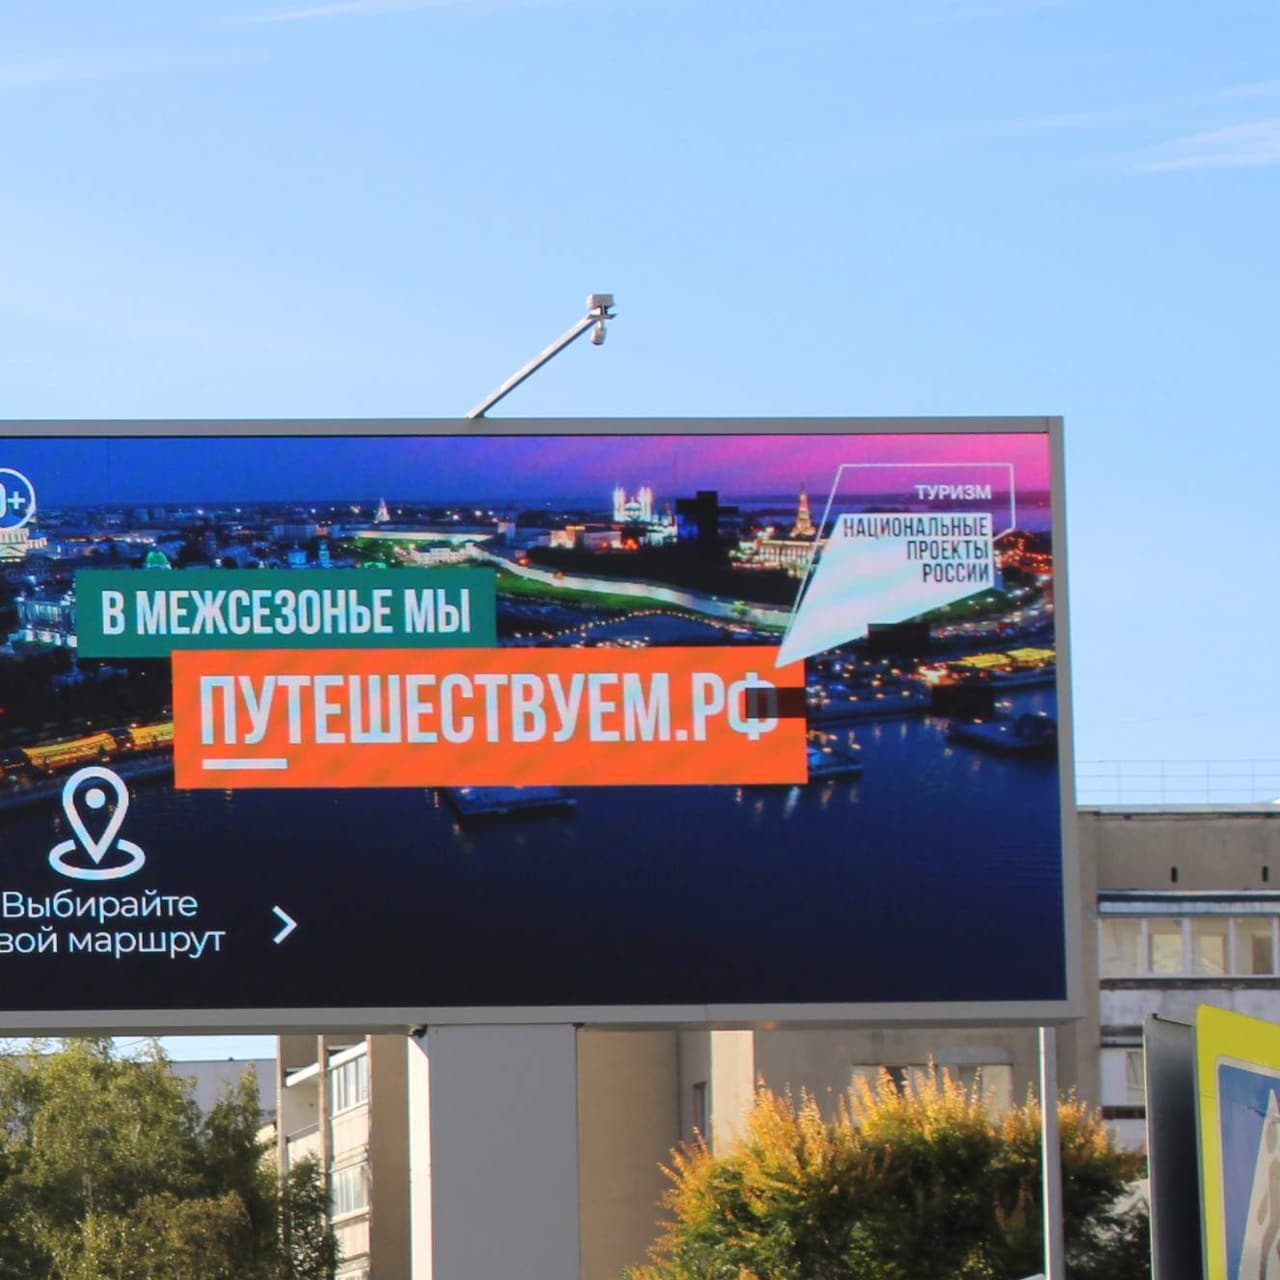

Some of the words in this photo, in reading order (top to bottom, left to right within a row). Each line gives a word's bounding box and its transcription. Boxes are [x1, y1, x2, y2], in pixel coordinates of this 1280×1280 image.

[915, 484, 991, 500] ТУРИЗМ
[842, 516, 989, 539] НАЦИОНАЛЬНЫЕ
[906, 539, 989, 561] ПРОЕКТЫ
[922, 562, 990, 584] РОССИИ
[101, 590, 126, 635] В
[135, 588, 393, 635] МЕЖСЕЗОНЬЕ
[403, 587, 471, 633] МЫ
[200, 671, 780, 745] ПУТЕШЕСТВУЕМ.РФ
[1, 888, 199, 924] Выбирайте
[68, 929, 226, 959] маршрут
